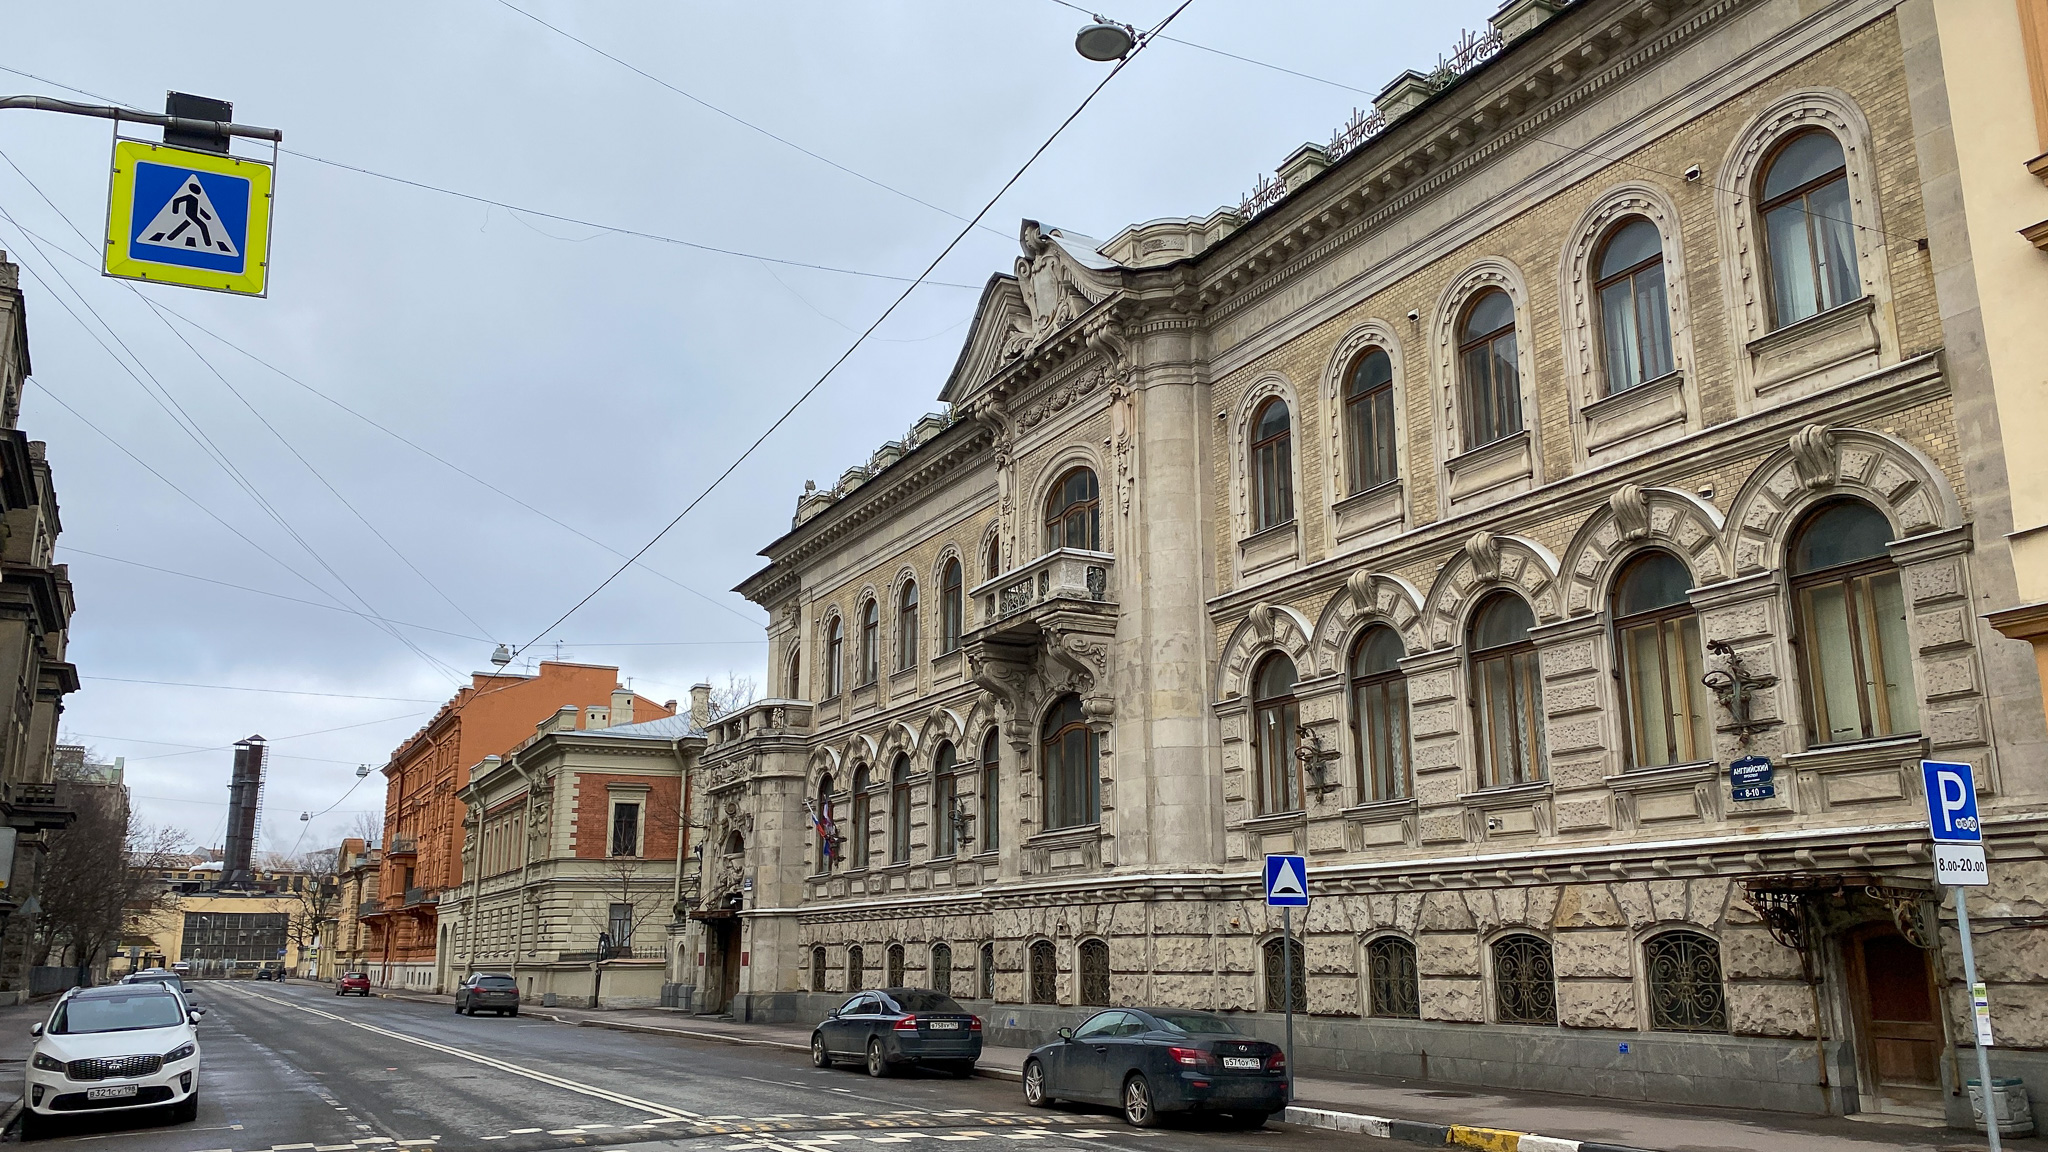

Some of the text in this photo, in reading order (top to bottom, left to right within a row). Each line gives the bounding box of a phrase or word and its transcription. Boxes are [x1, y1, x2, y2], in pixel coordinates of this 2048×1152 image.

[1733, 763, 1769, 776] АНГЛИЙСКИЙ
[1745, 788, 1760, 798] 8-10
[1937, 770, 1967, 832] P
[1968, 819, 1977, 830] 20
[1938, 858, 1985, 872] 8.00-20.00
